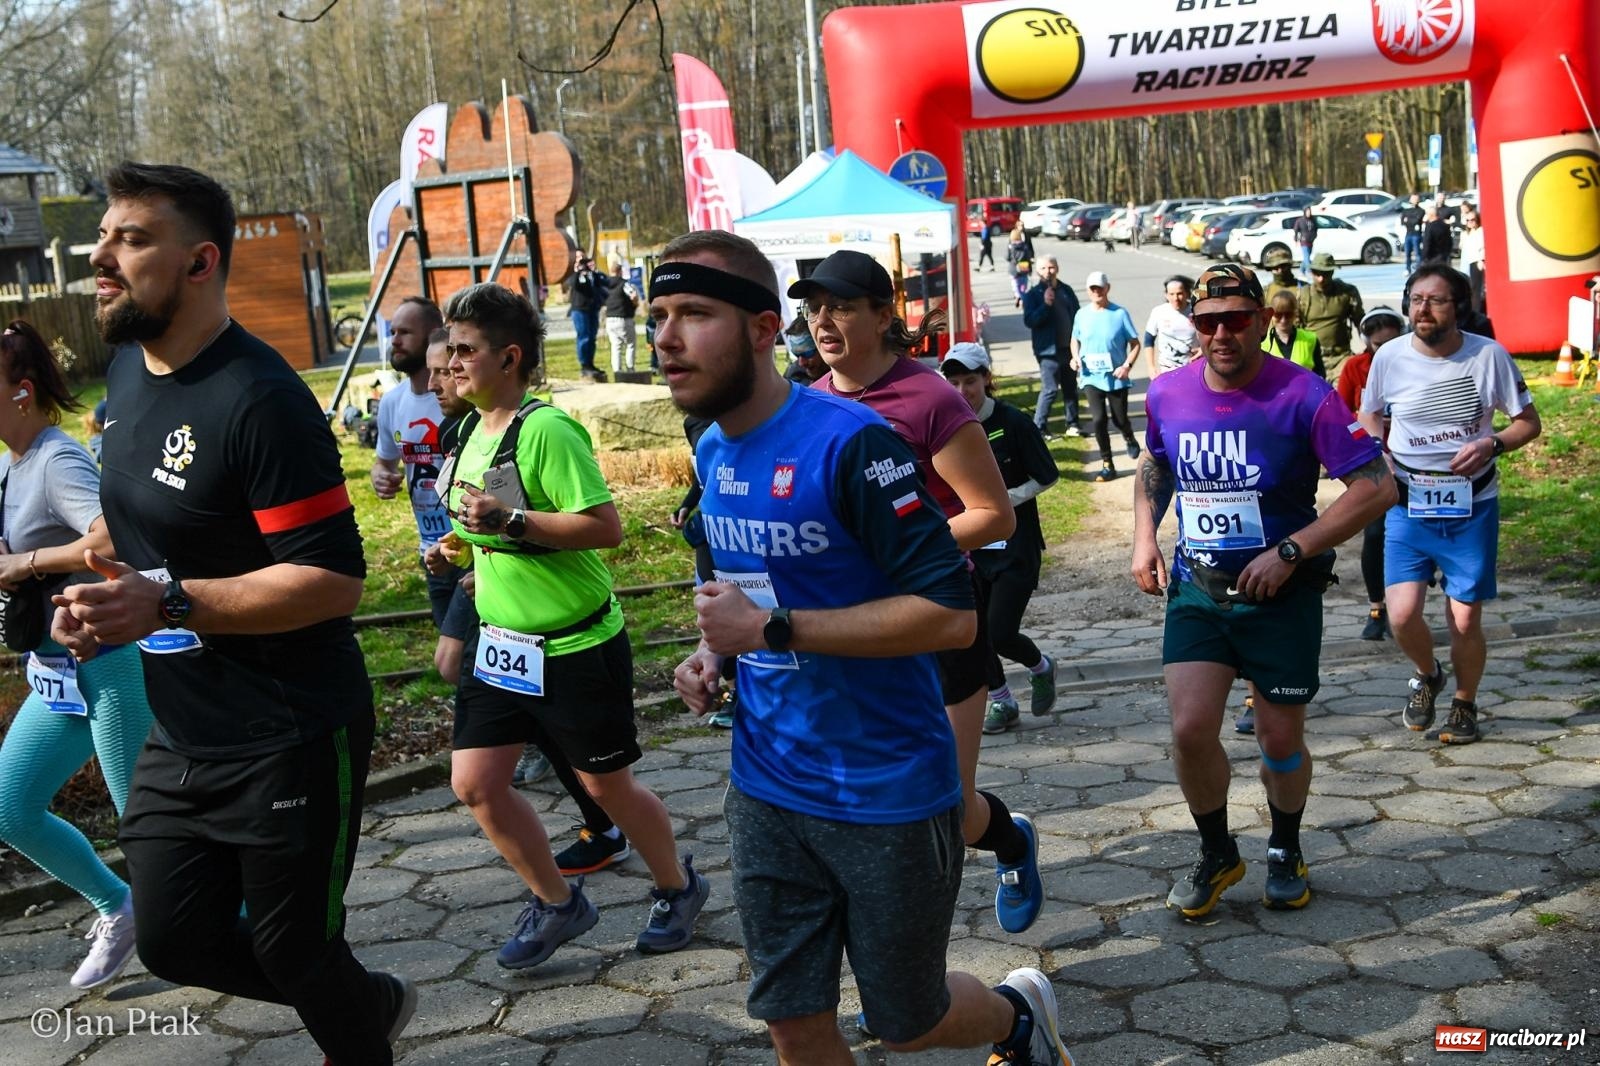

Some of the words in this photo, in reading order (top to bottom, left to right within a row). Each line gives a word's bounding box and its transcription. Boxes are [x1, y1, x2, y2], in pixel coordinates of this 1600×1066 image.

[1107, 13, 1339, 58] TWARDZIELA
[1131, 53, 1316, 93] RACIBÓRZ
[1570, 165, 1600, 189] SI
[1179, 430, 1247, 480] RUN
[151, 467, 187, 491] POLSKA
[1211, 496, 1252, 504] TWARDZIELA
[1423, 490, 1457, 506] 114
[422, 515, 446, 531] 011
[1197, 512, 1243, 535] 091
[485, 645, 529, 677] 034
[34, 674, 65, 700] 077
[1281, 687, 1309, 695] TERREX
